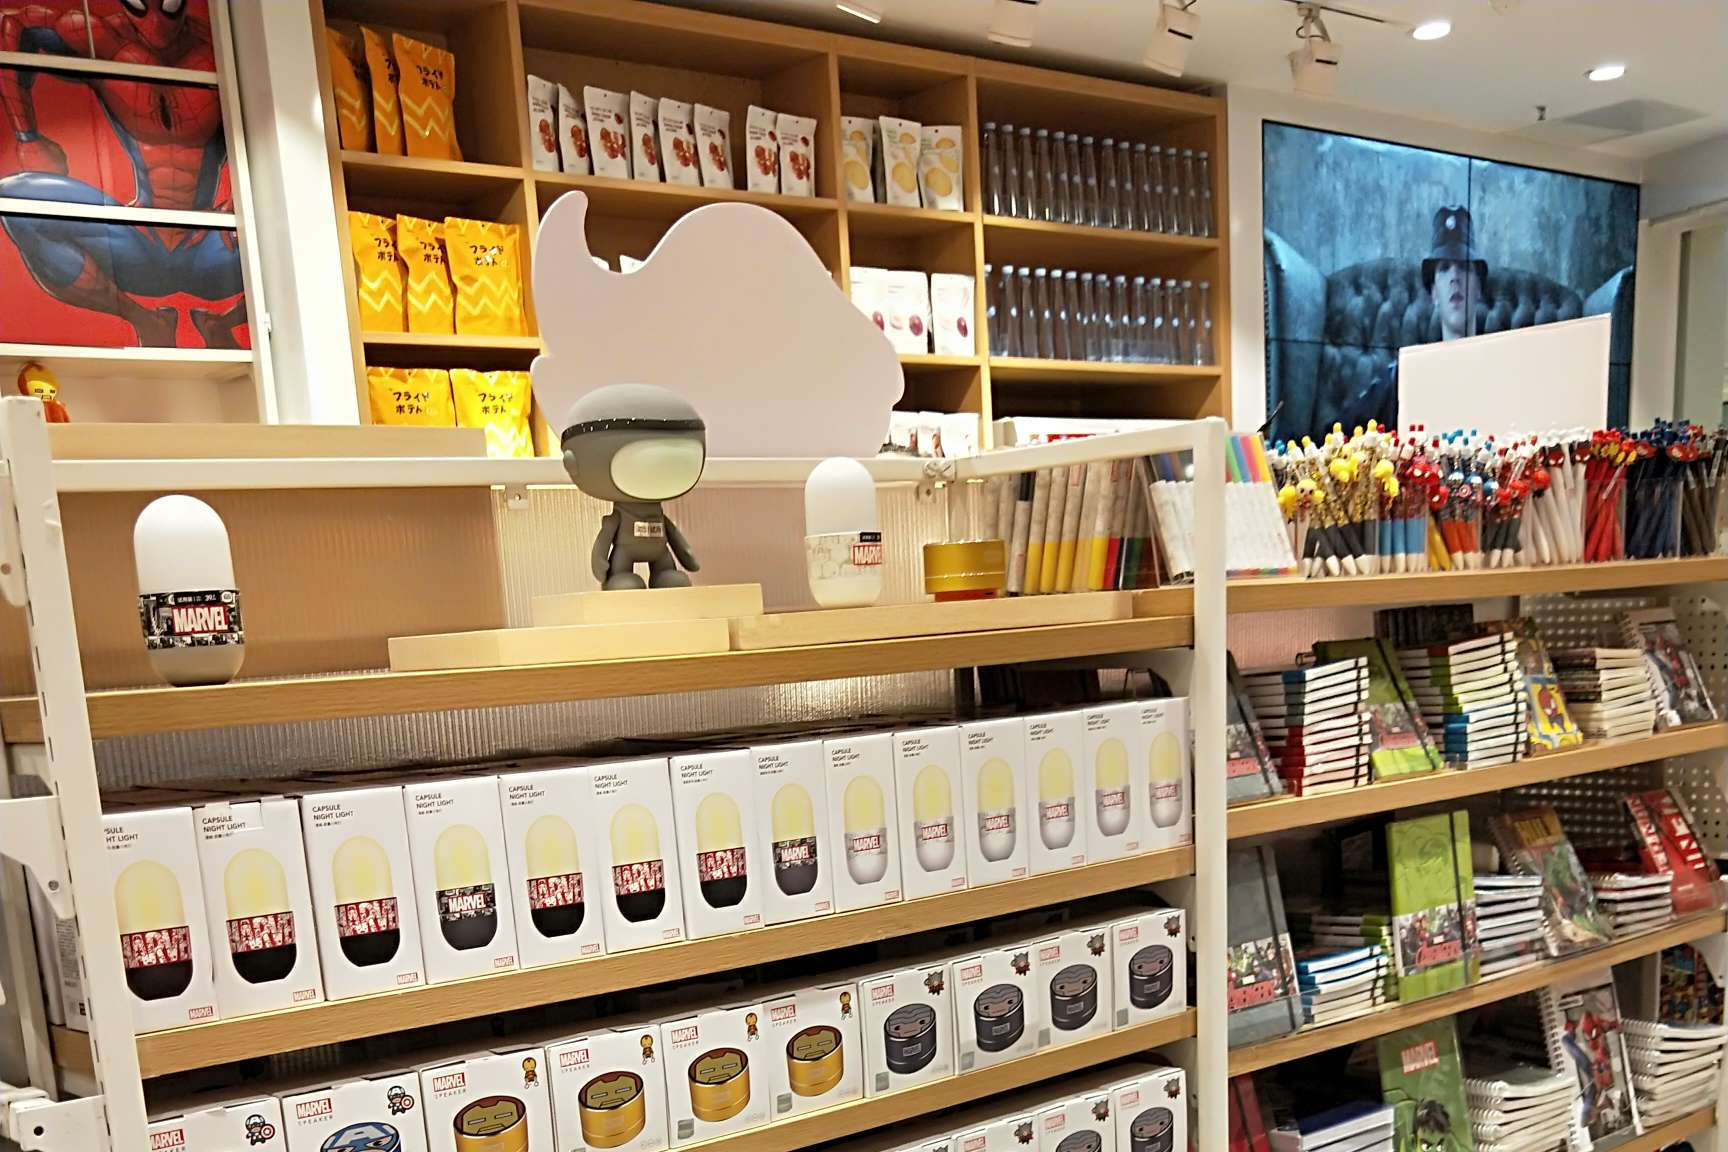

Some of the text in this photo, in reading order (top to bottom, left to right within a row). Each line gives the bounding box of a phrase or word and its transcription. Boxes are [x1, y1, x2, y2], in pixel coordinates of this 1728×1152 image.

[395, 404, 423, 415] ポテト
[172, 604, 229, 634] MARVEL
[594, 774, 618, 782] CAPSULE
[508, 784, 534, 793] CAPSULE
[530, 790, 545, 798] LIGHT
[415, 792, 442, 801] CAPSULE
[312, 804, 341, 813] CAPSULE
[416, 799, 454, 809] NIGHT LIGHT
[202, 815, 233, 825] CAPSULE
[313, 810, 354, 821] NIGHT LIGHT
[203, 822, 246, 833] NIGHT LIGHT
[921, 823, 949, 841] MARVEL
[118, 833, 139, 842] LIGHT
[853, 834, 881, 853] MARVEL
[780, 844, 811, 864] MARVEL
[447, 891, 488, 915] MARVEL
[671, 1025, 698, 1044] MARVEL
[560, 1048, 589, 1068] MARVEL
[433, 1072, 466, 1093] MARVEL
[434, 1089, 467, 1099] SPEAKER
[296, 1098, 332, 1119] MARVEL
